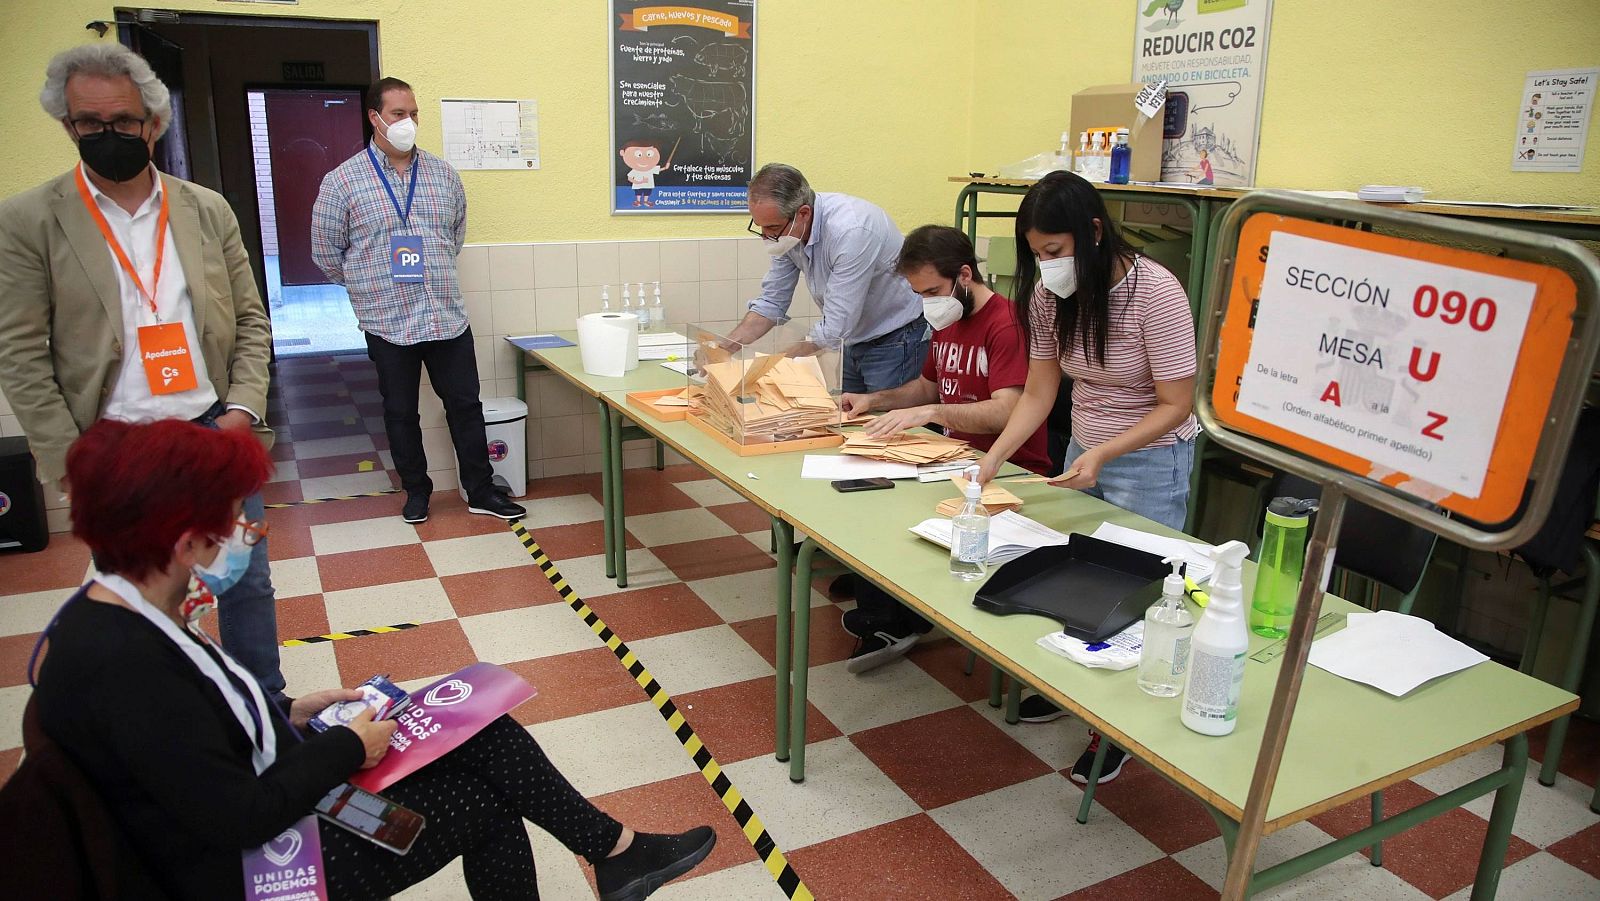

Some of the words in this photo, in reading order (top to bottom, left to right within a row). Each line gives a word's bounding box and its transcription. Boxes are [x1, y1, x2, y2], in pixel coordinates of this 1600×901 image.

[641, 12, 667, 22] Carne,
[668, 10, 695, 20] huevos
[696, 12, 701, 23] y
[702, 15, 732, 28] pescado
[1143, 31, 1214, 57] REDUCIR
[1220, 26, 1256, 50] CO2
[620, 44, 643, 56] Fuente
[652, 55, 658, 65] y
[1182, 71, 1189, 82] O
[1191, 70, 1202, 81] EN
[1534, 79, 1550, 87] Let's
[1551, 78, 1568, 88] Stay
[1569, 76, 1589, 85] Safe!
[620, 80, 632, 89] Son
[632, 81, 666, 91] esenciales
[622, 90, 638, 99] para
[638, 90, 664, 100] nuestro
[623, 98, 663, 108] crecimiento
[673, 164, 703, 174] Fortalece
[703, 165, 715, 174] tus
[685, 173, 691, 181] y
[691, 173, 703, 182] tus
[703, 173, 732, 181] defensas
[706, 191, 711, 199] y
[1285, 265, 1391, 309] SECCIÓN
[1412, 284, 1498, 332] 090
[145, 346, 187, 361] Apoderado
[1318, 333, 1384, 369] MESA
[1407, 346, 1441, 382] U
[161, 366, 179, 378] Cs
[1256, 363, 1270, 374] De
[1270, 367, 1279, 377] la
[1280, 371, 1299, 385] letra
[1319, 380, 1342, 408] A
[1371, 403, 1378, 411] a
[1380, 402, 1390, 414] la
[1420, 410, 1449, 441] Z
[1282, 400, 1313, 420] (Orden
[1313, 412, 1356, 434] alfabético
[1357, 428, 1390, 446] primer
[1389, 440, 1433, 463] apellido)
[407, 702, 442, 733] IDAS
[253, 865, 317, 884] UNIDAS
[254, 875, 318, 895] PODEMOS
